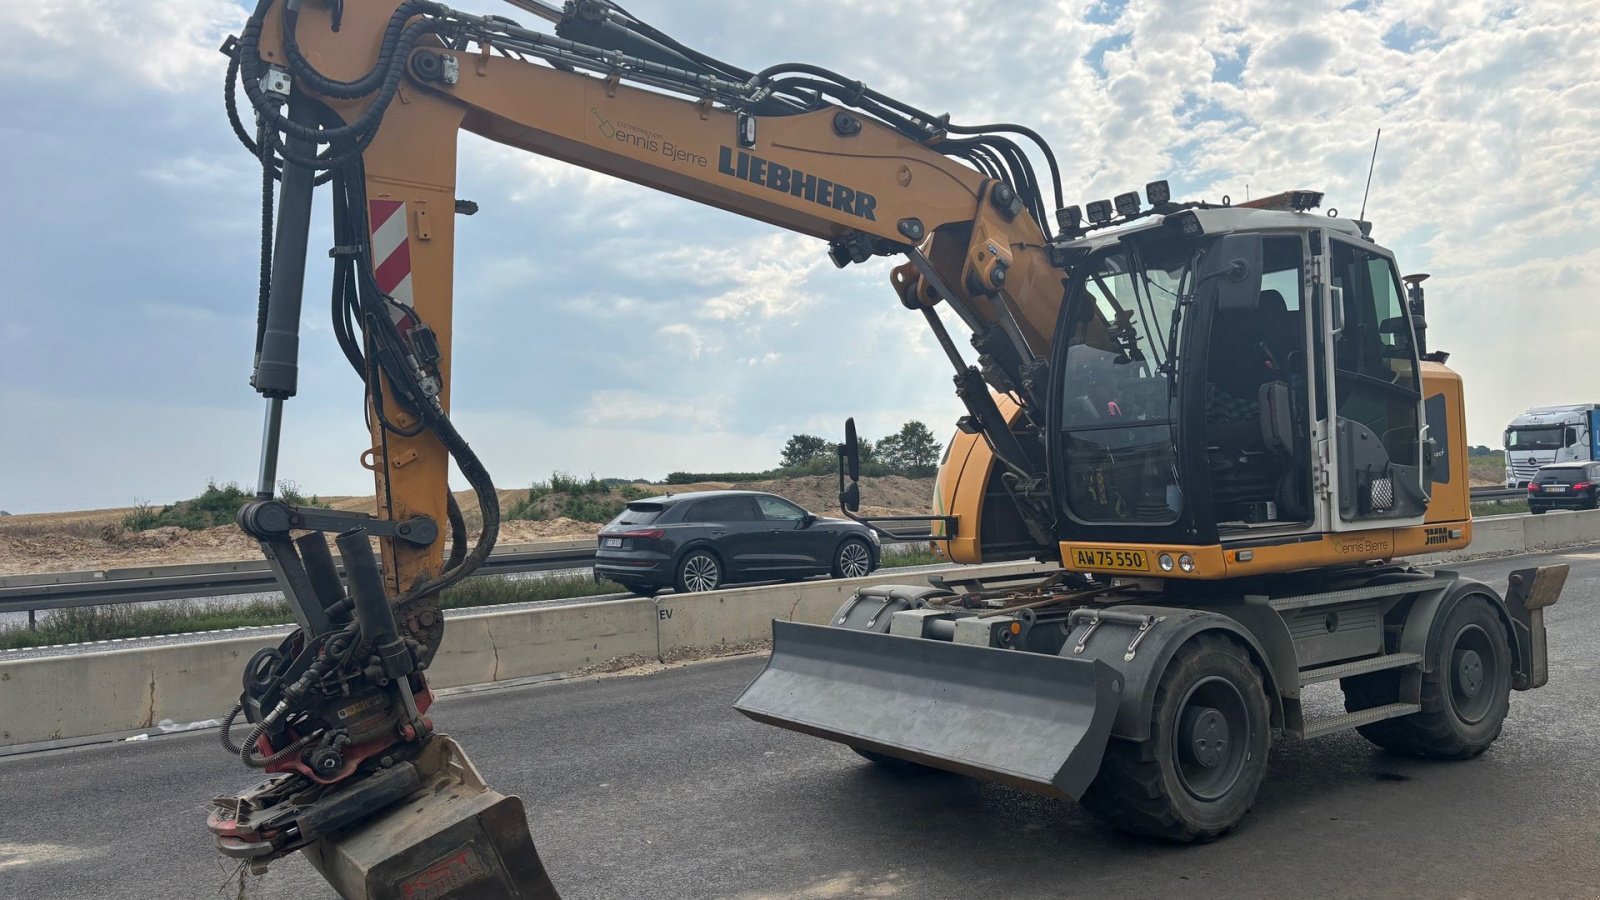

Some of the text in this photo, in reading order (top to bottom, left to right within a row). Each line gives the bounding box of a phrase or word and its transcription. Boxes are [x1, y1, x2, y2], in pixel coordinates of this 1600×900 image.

[662, 141, 708, 168] Bjerre
[718, 144, 877, 221] LIEBHERR
[1365, 539, 1389, 554] Bjerre
[1078, 550, 1143, 568] AW 75 550
[659, 608, 673, 620] EV
